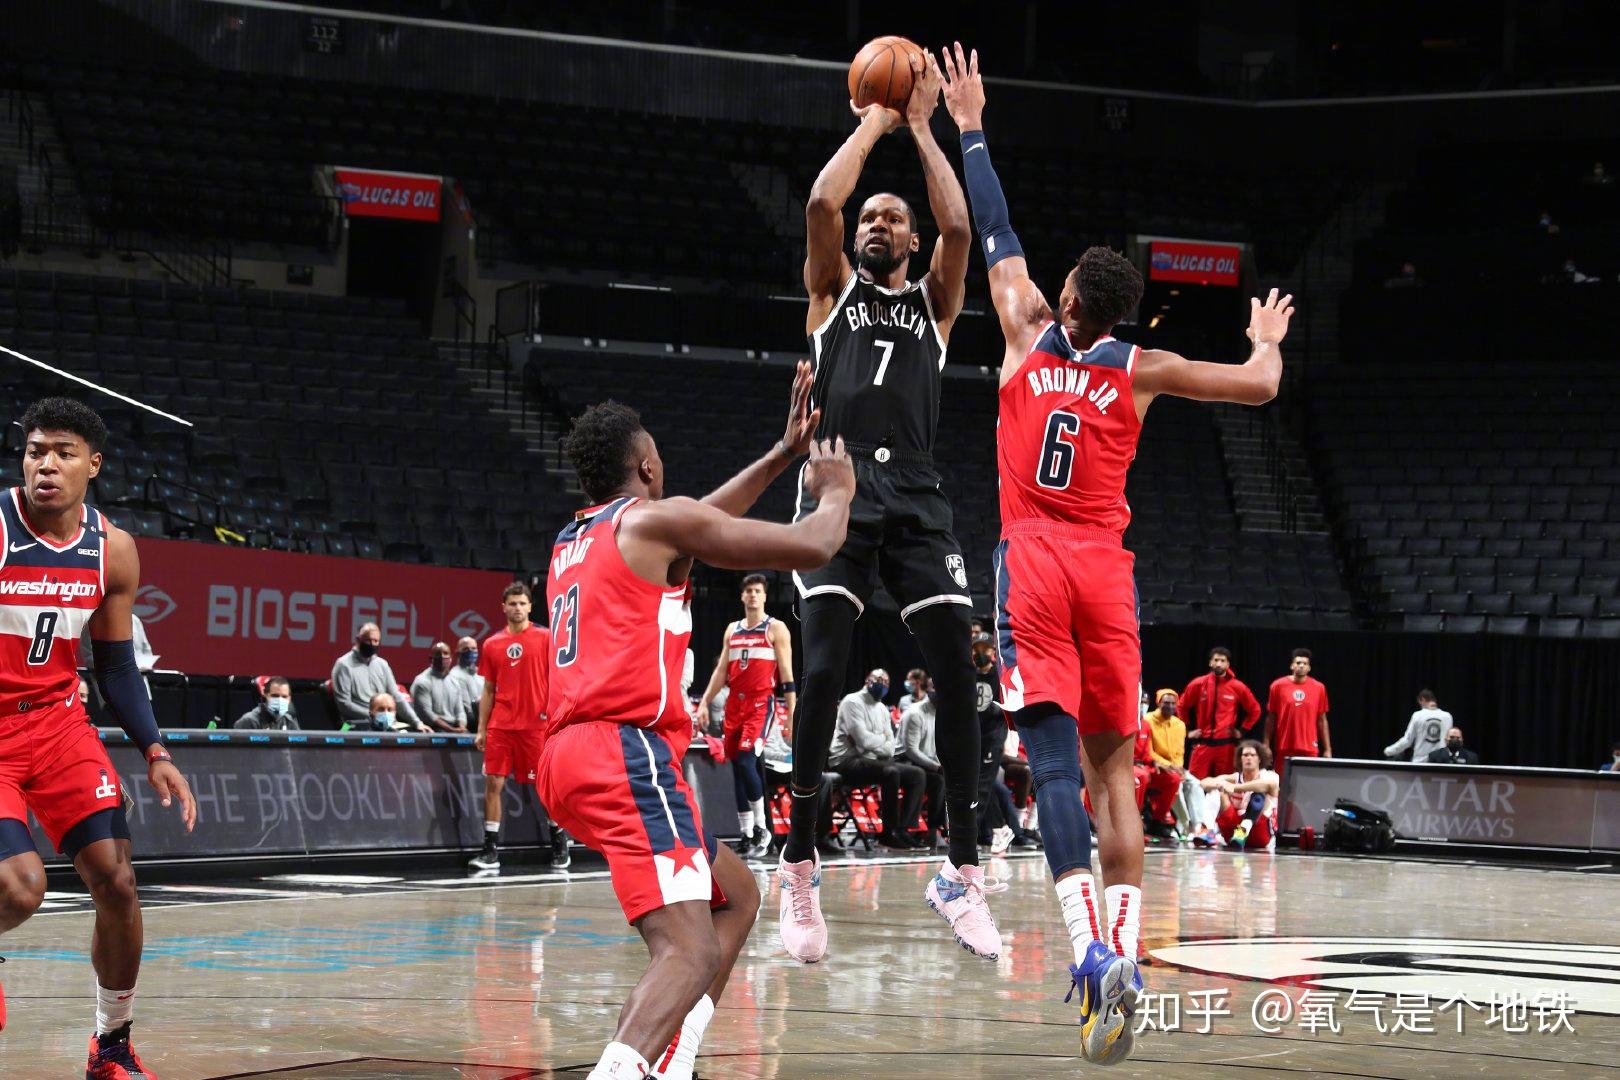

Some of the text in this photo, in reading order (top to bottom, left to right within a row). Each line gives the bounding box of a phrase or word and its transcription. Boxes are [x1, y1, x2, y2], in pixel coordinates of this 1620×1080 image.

[361, 186, 435, 207] LUCAS OIL
[1172, 254, 1235, 272] LUCAS OIL
[845, 302, 926, 341] BROOKLYN
[872, 339, 895, 386] 7
[1027, 366, 1119, 416] BROWN JR.
[1035, 408, 1081, 491] 6
[77, 548, 99, 557] GEICO
[0, 574, 97, 602] washington
[206, 584, 435, 648] BIOSTEEL
[27, 609, 60, 666] 8
[740, 649, 750, 670] 9
[252, 772, 437, 826] BROOKLYN
[441, 771, 523, 819] NES
[1360, 774, 1516, 814] QATAR
[1396, 813, 1515, 840] AIRWAYS
